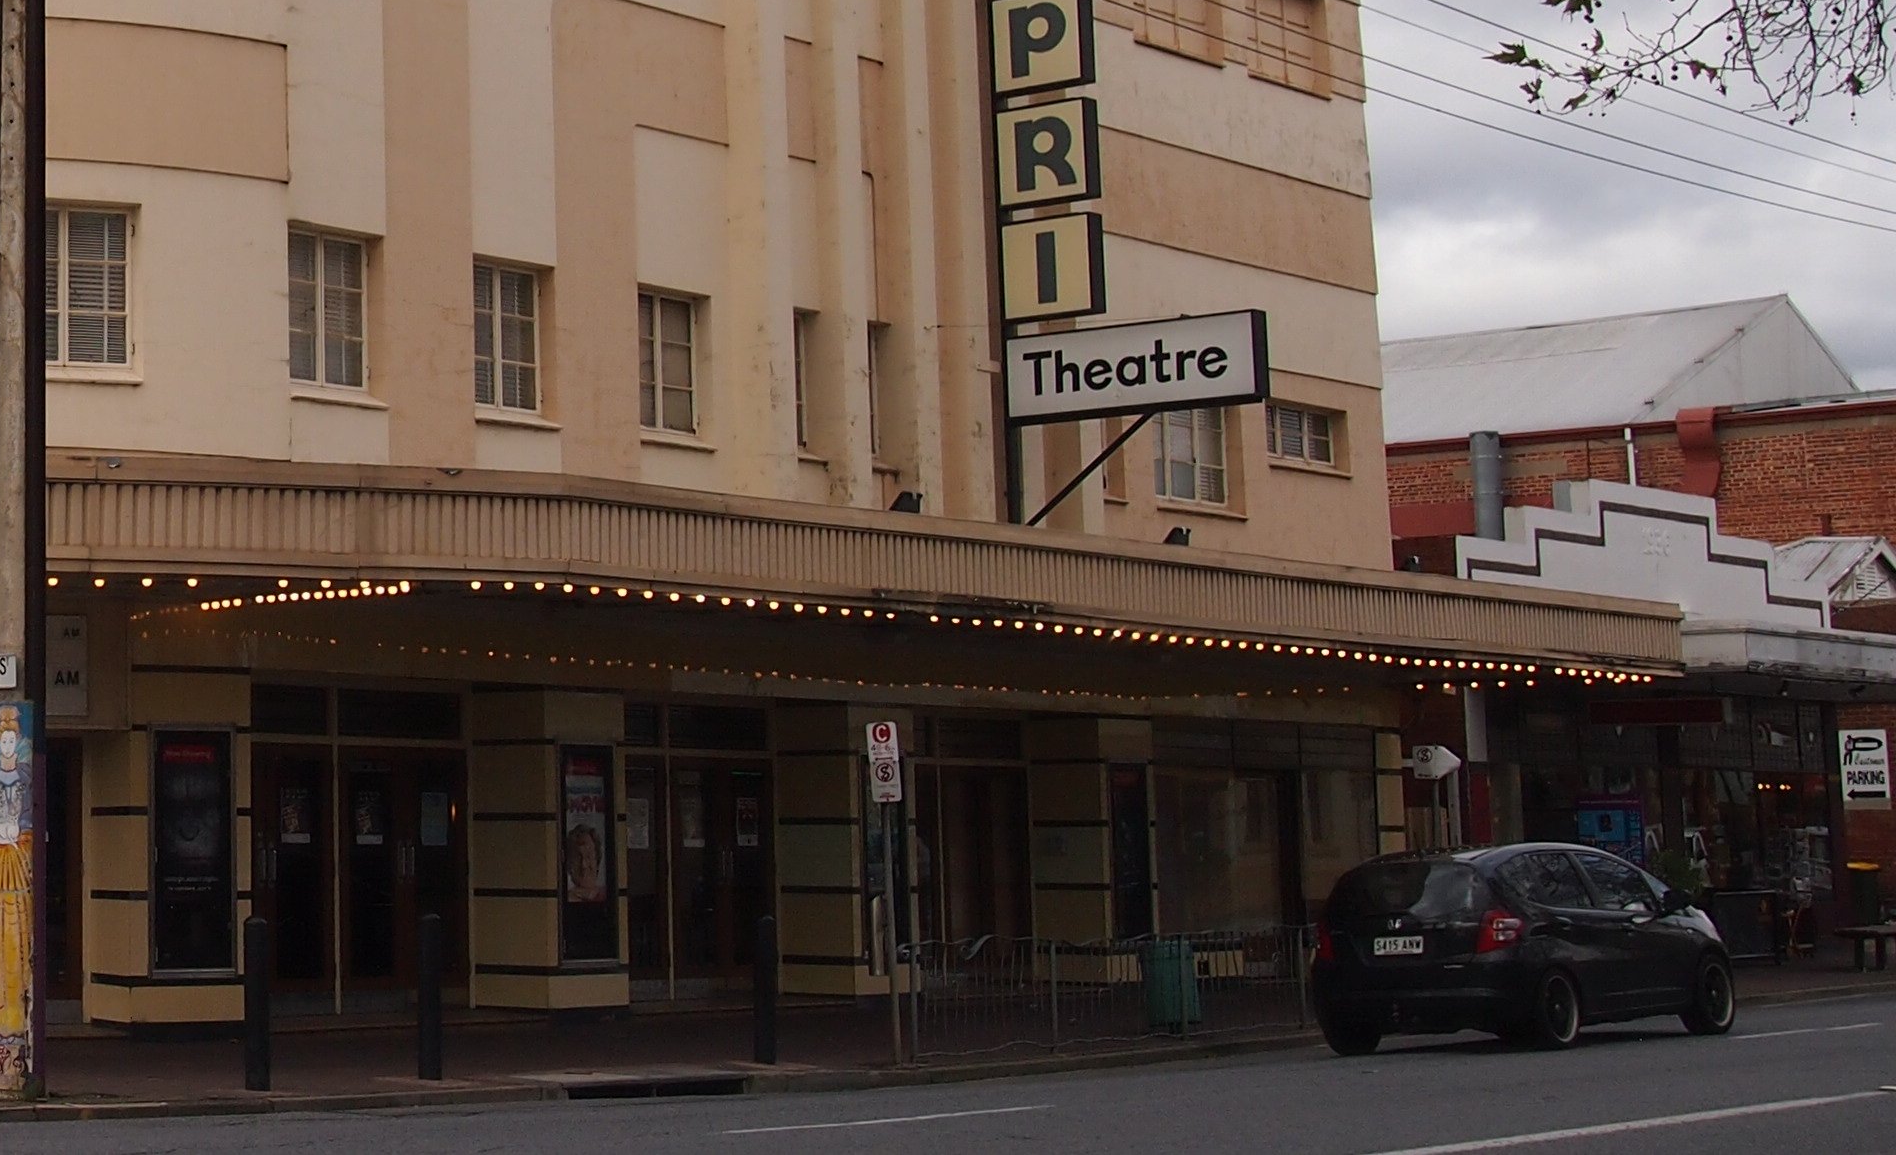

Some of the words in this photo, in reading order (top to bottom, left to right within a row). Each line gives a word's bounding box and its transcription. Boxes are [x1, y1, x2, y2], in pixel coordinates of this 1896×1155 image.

[1022, 339, 1229, 398] Theatre
[54, 671, 80, 686] AM
[1847, 771, 1886, 785] PARKING
